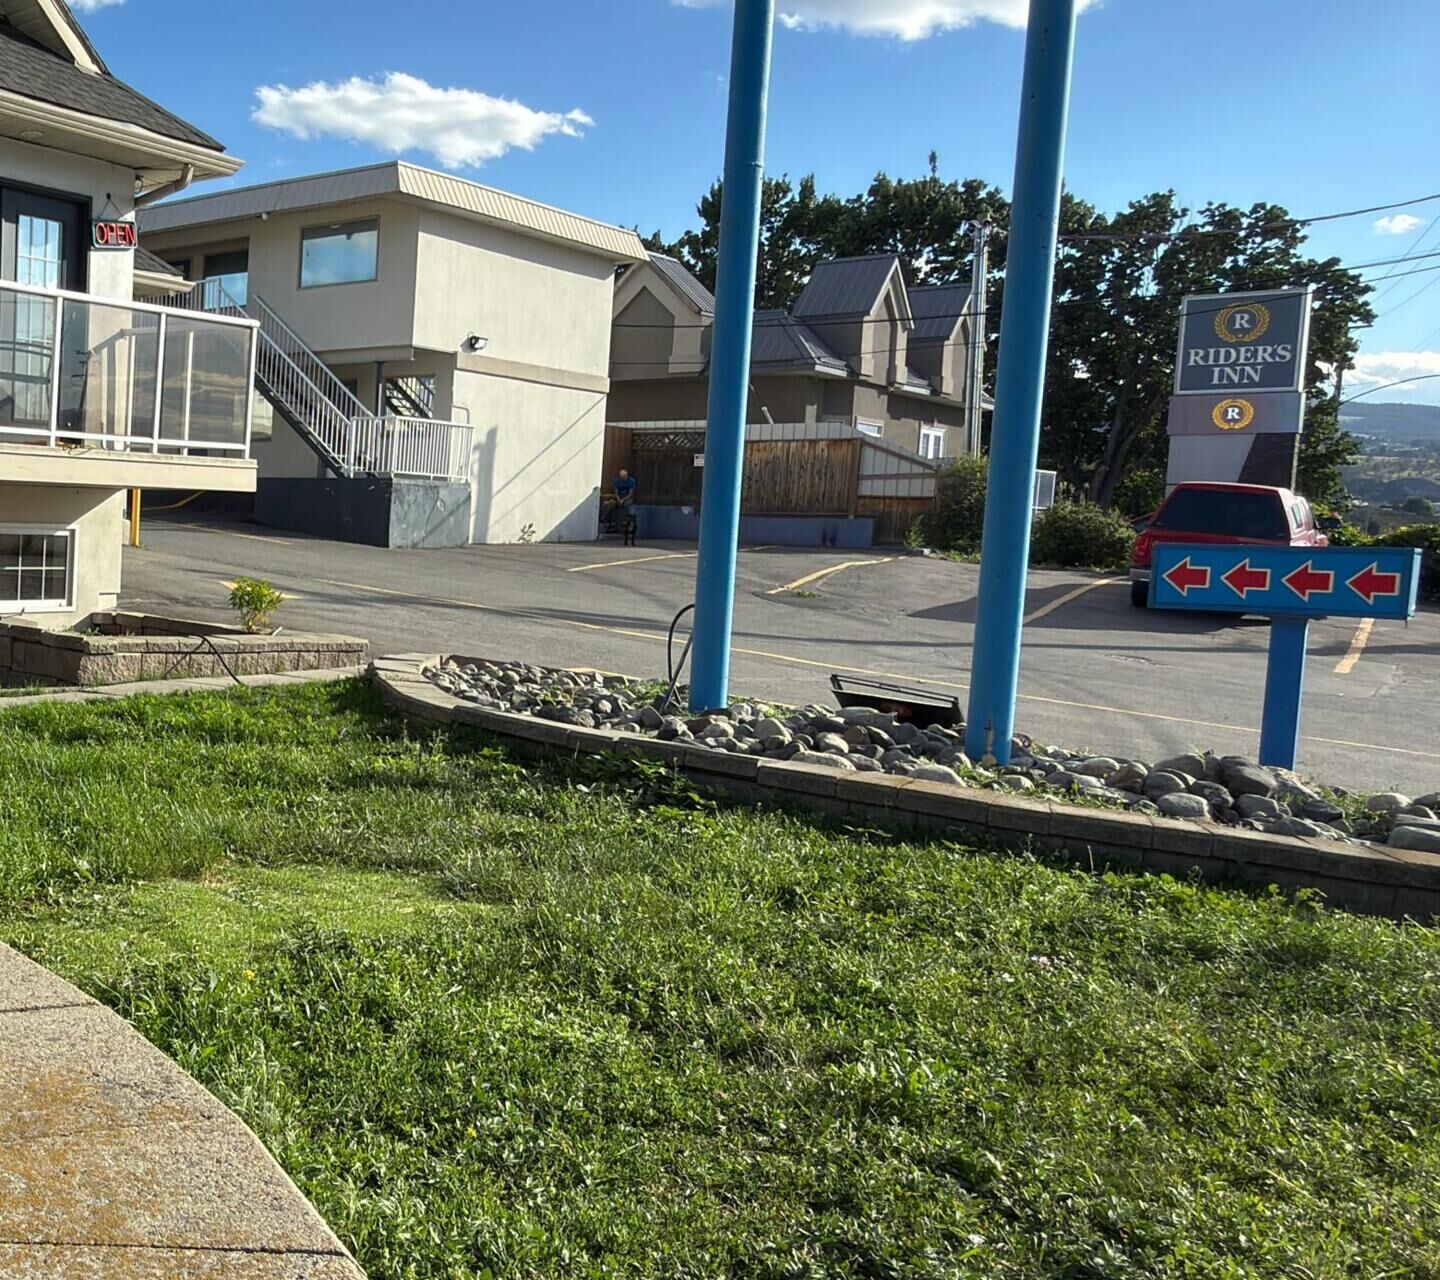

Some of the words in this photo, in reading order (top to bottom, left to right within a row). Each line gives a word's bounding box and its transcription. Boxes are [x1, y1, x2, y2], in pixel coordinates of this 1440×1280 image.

[95, 222, 136, 245] OPEN
[1232, 313, 1251, 329] R
[1186, 344, 1292, 367] RIDER'S
[1210, 365, 1264, 385] INN
[1226, 407, 1240, 420] R
